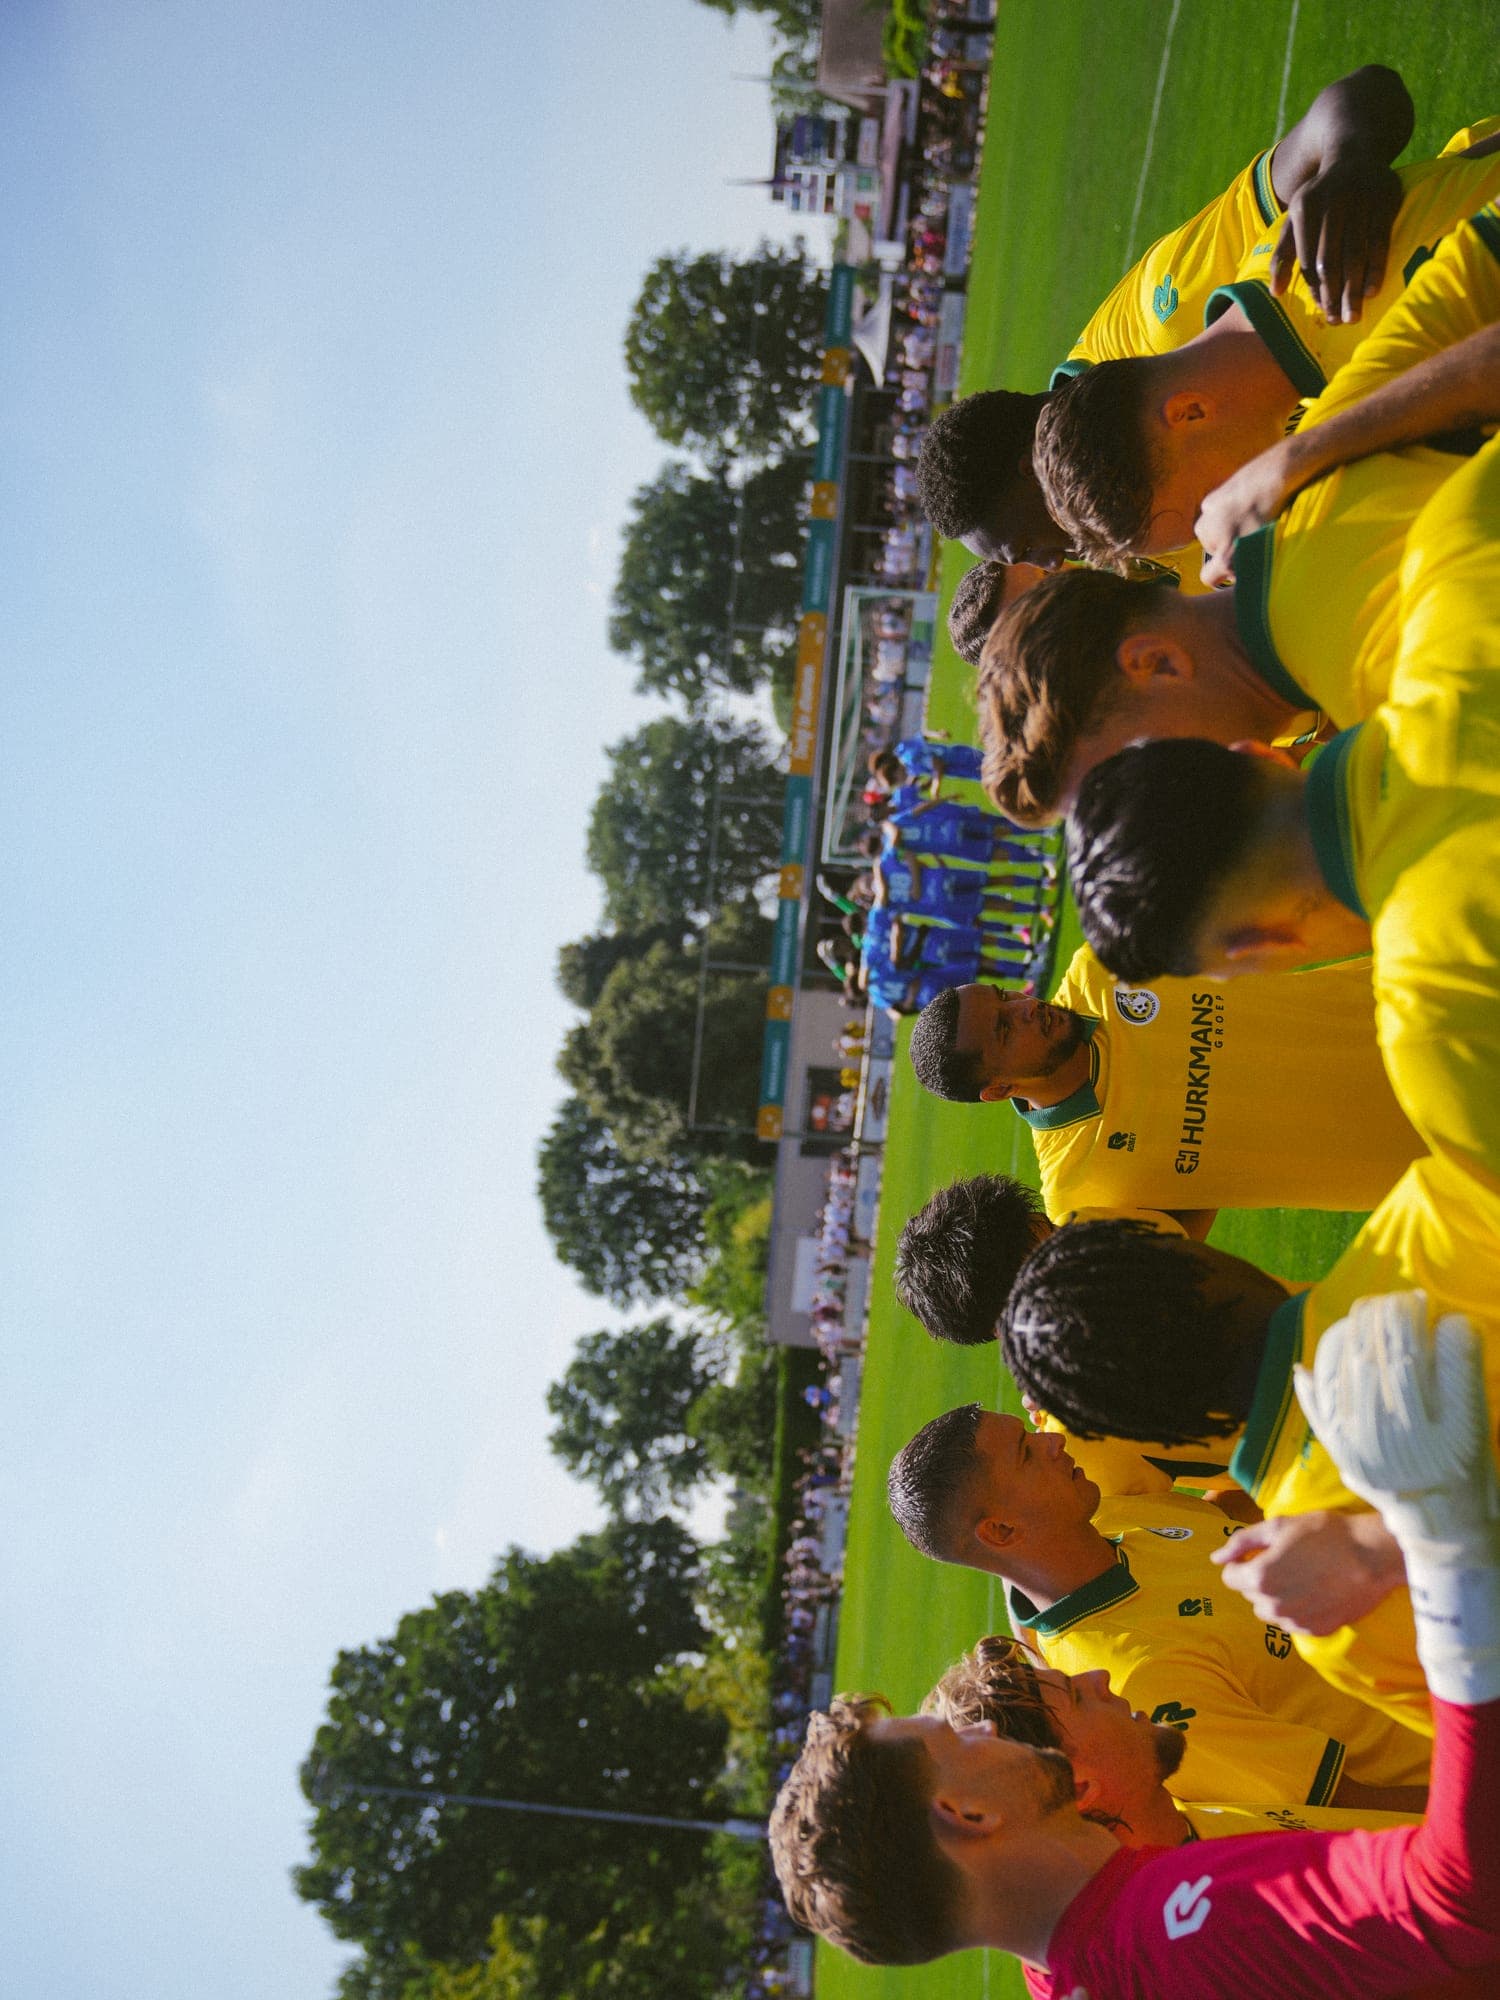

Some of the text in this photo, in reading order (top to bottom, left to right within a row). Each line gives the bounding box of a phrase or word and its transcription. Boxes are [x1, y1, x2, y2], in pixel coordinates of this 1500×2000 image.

[1214, 995, 1224, 1049] GROEP
[1180, 993, 1213, 1145] HURKMANS
[1127, 1132, 1136, 1153] ROBEY
[1203, 1597, 1213, 1617] ROBEY
